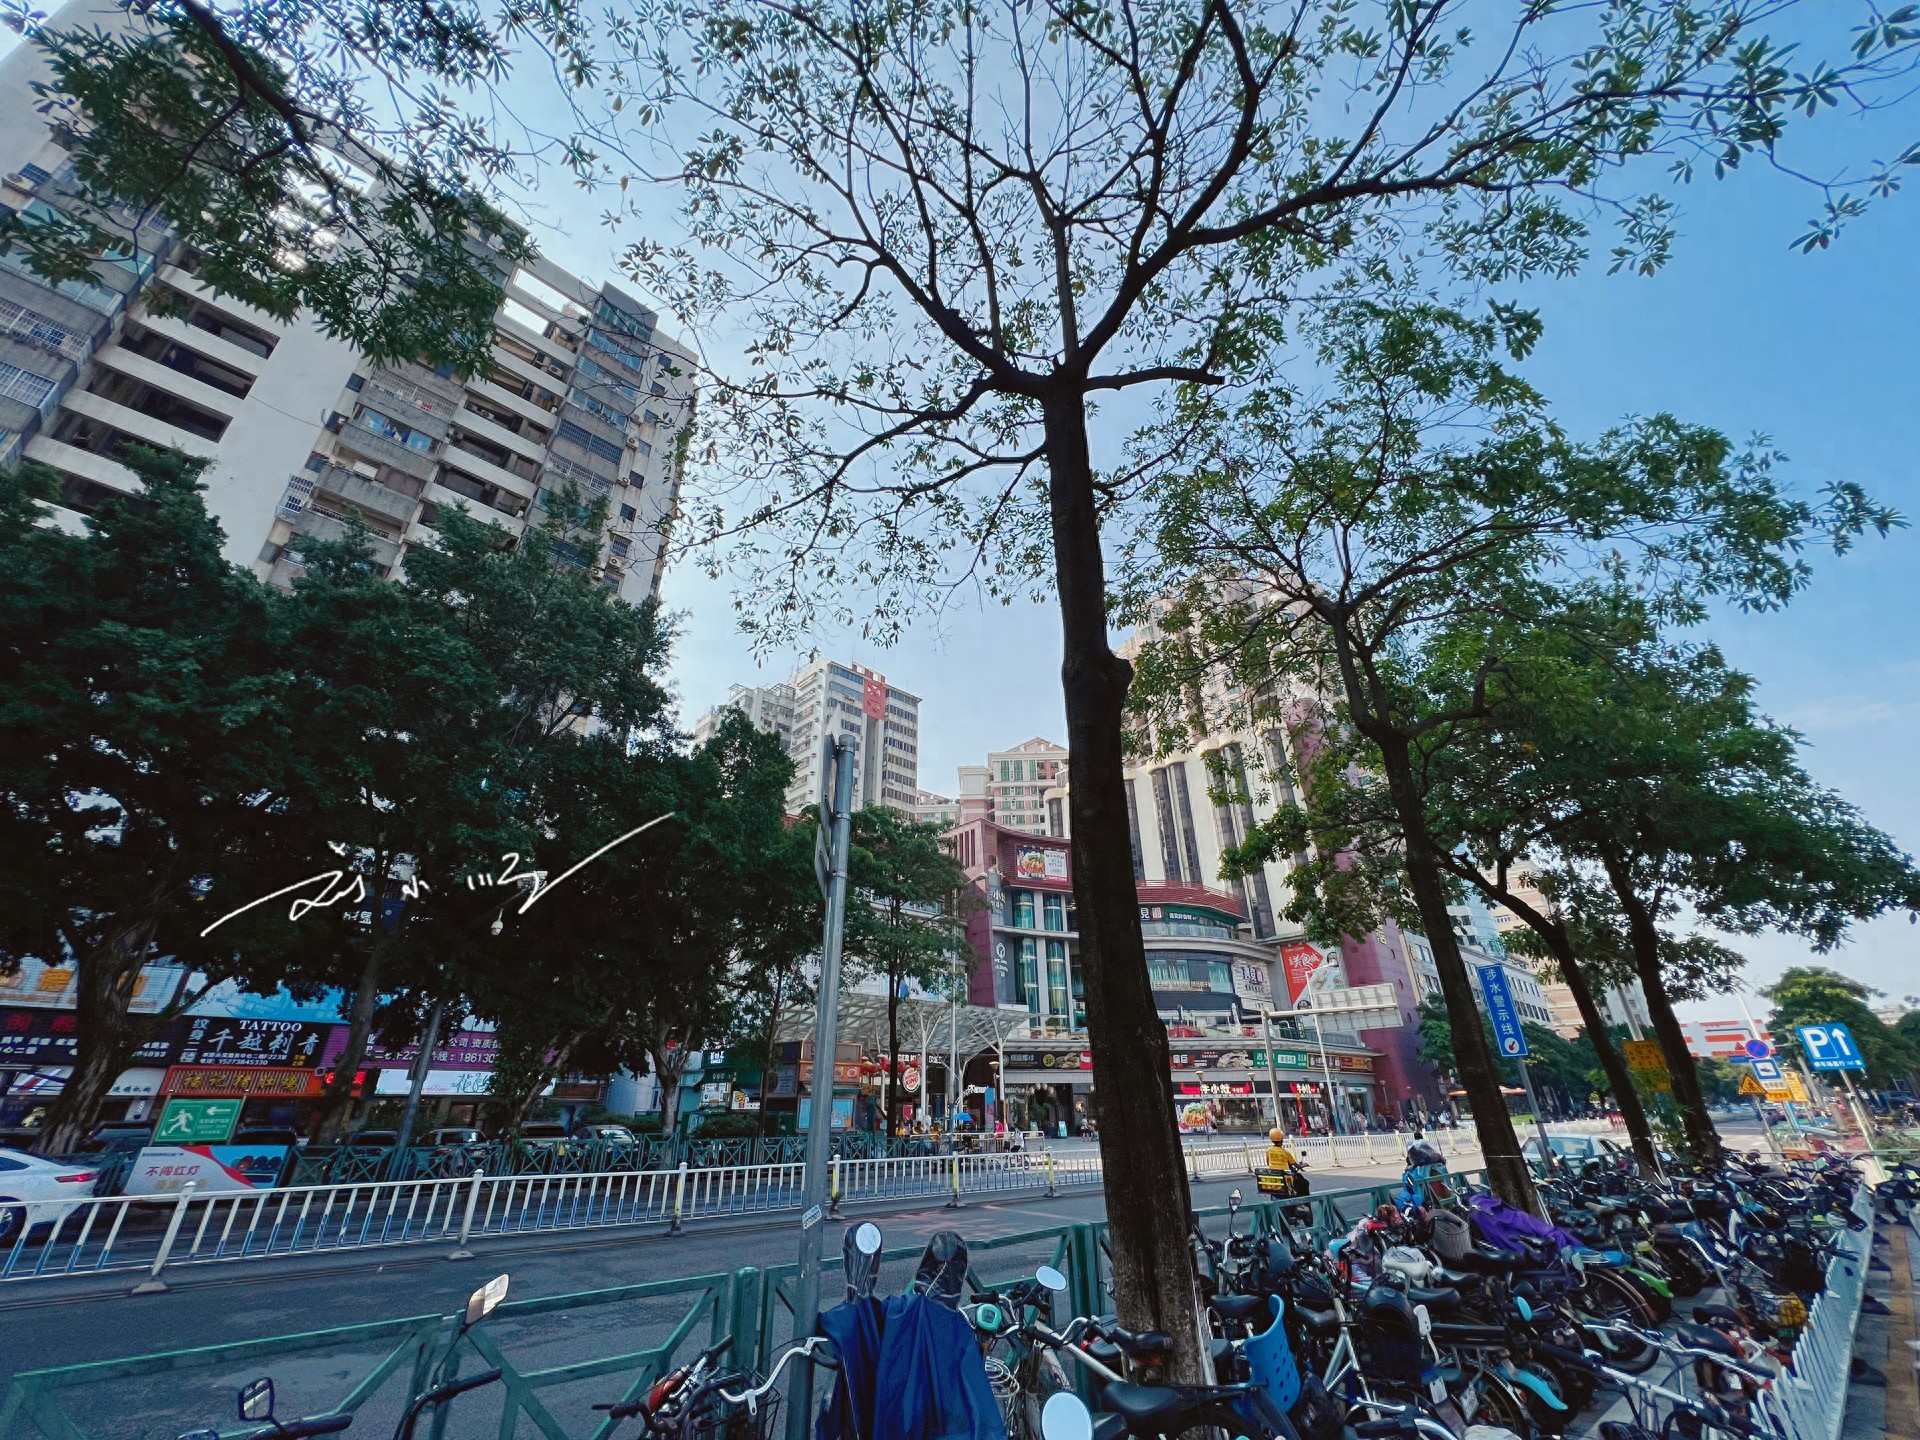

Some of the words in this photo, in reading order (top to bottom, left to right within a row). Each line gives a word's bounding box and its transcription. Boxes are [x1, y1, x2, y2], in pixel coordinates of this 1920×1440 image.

[1484, 969, 1515, 1035] 涉水警示线
[239, 1020, 303, 1032] TATTOO
[1802, 1029, 1829, 1058] P
[144, 1165, 202, 1177] 不闯红灯
